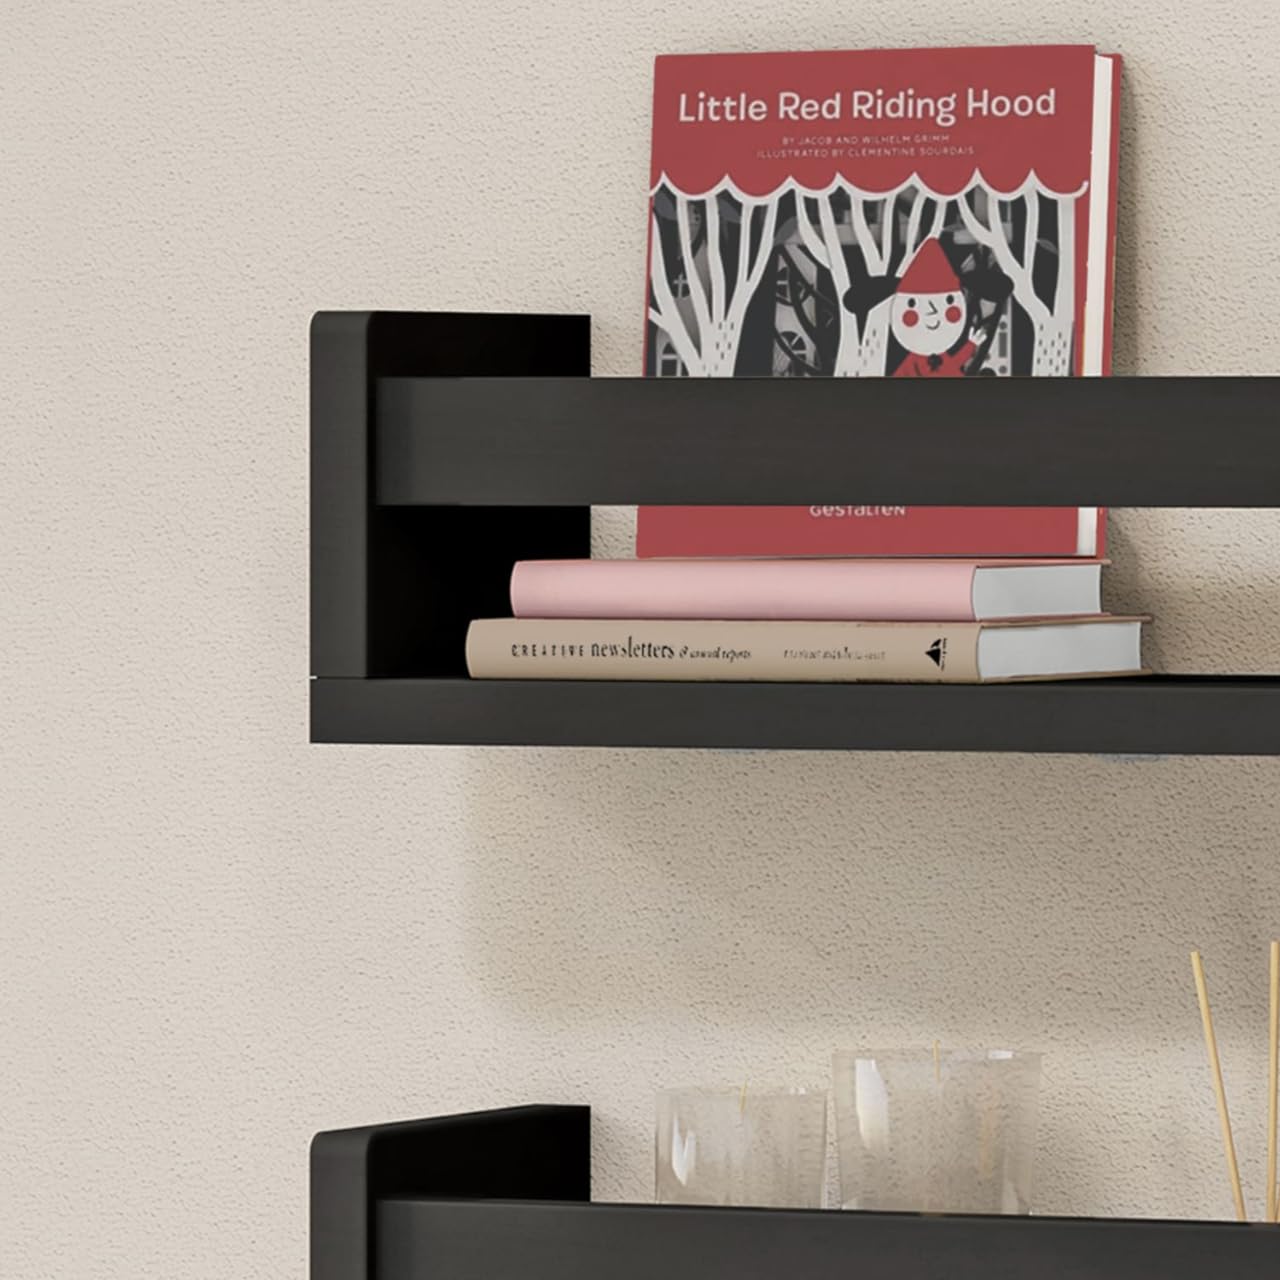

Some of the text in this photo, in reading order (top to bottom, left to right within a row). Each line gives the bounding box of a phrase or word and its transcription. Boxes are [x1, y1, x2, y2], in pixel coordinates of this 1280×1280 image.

[678, 87, 1057, 126] Little Red Riding Hood
[782, 133, 950, 145] BY JACOB AND WILHELM GRIMM
[511, 643, 584, 658] CREATIVE
[591, 636, 675, 659] newsletters
